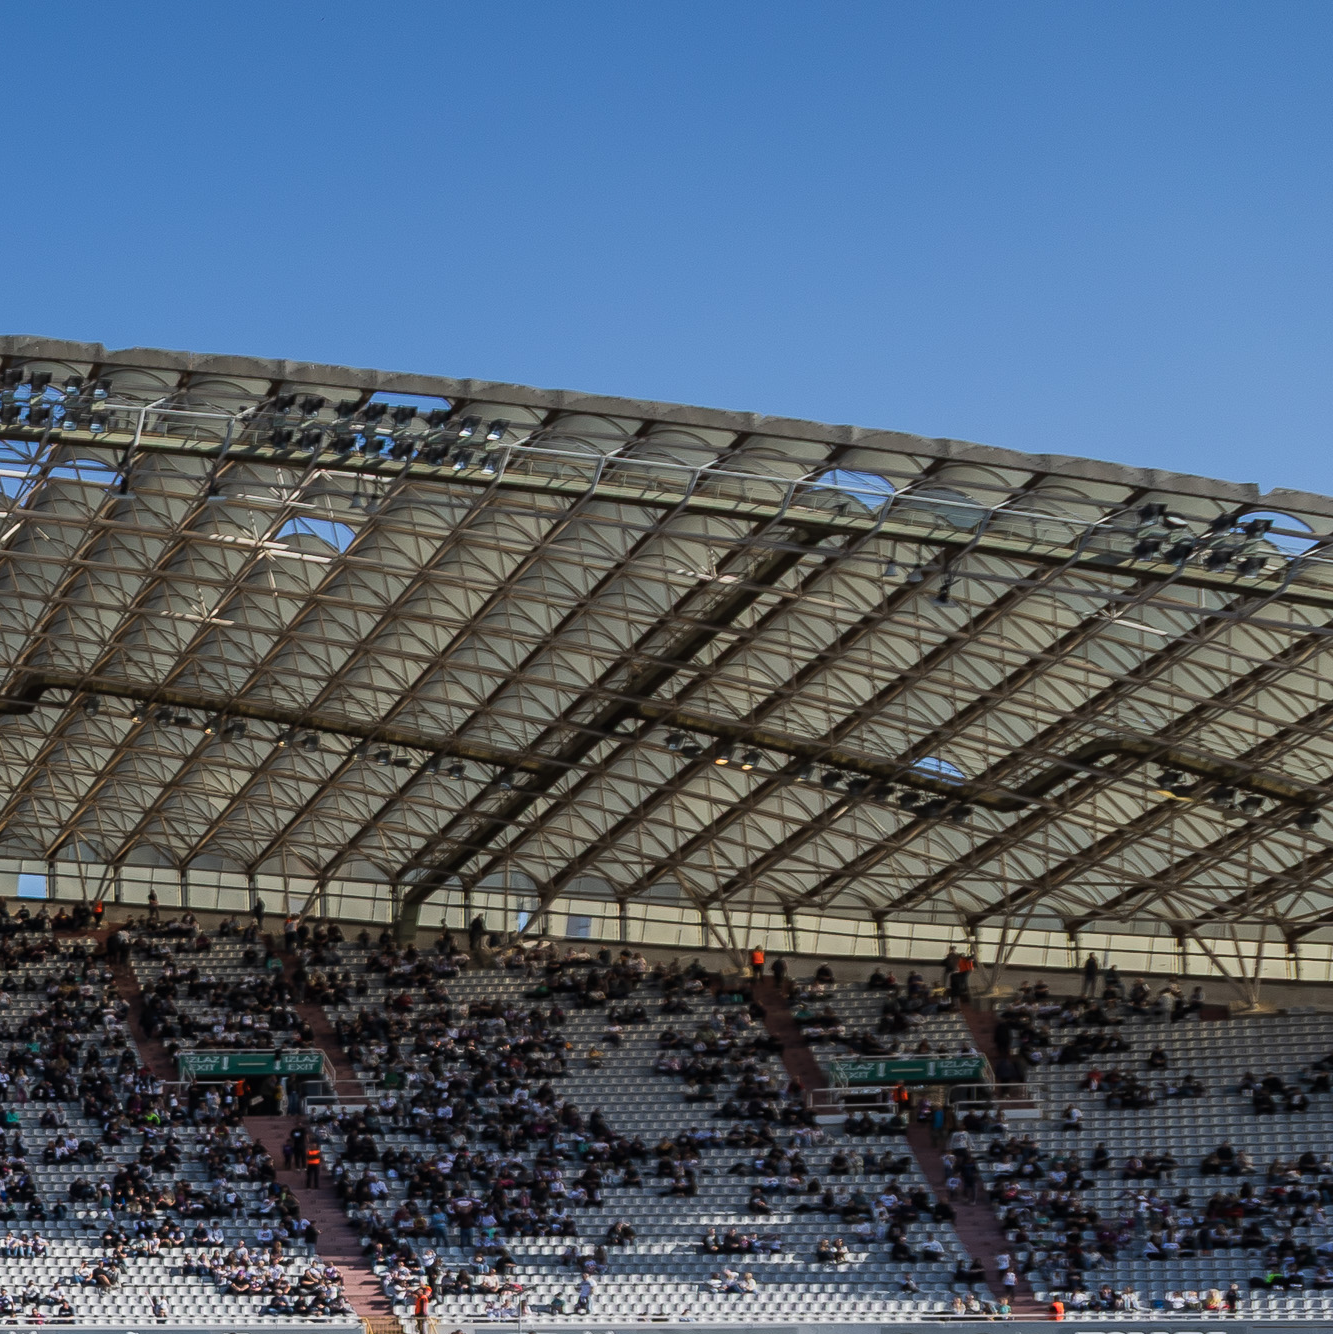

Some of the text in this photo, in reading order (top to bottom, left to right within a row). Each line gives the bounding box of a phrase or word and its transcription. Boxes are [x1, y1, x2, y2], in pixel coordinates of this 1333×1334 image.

[284, 1055, 319, 1063] IZLAZ
[288, 1063, 315, 1071] EXIT
[940, 1060, 980, 1068] IZLAZ
